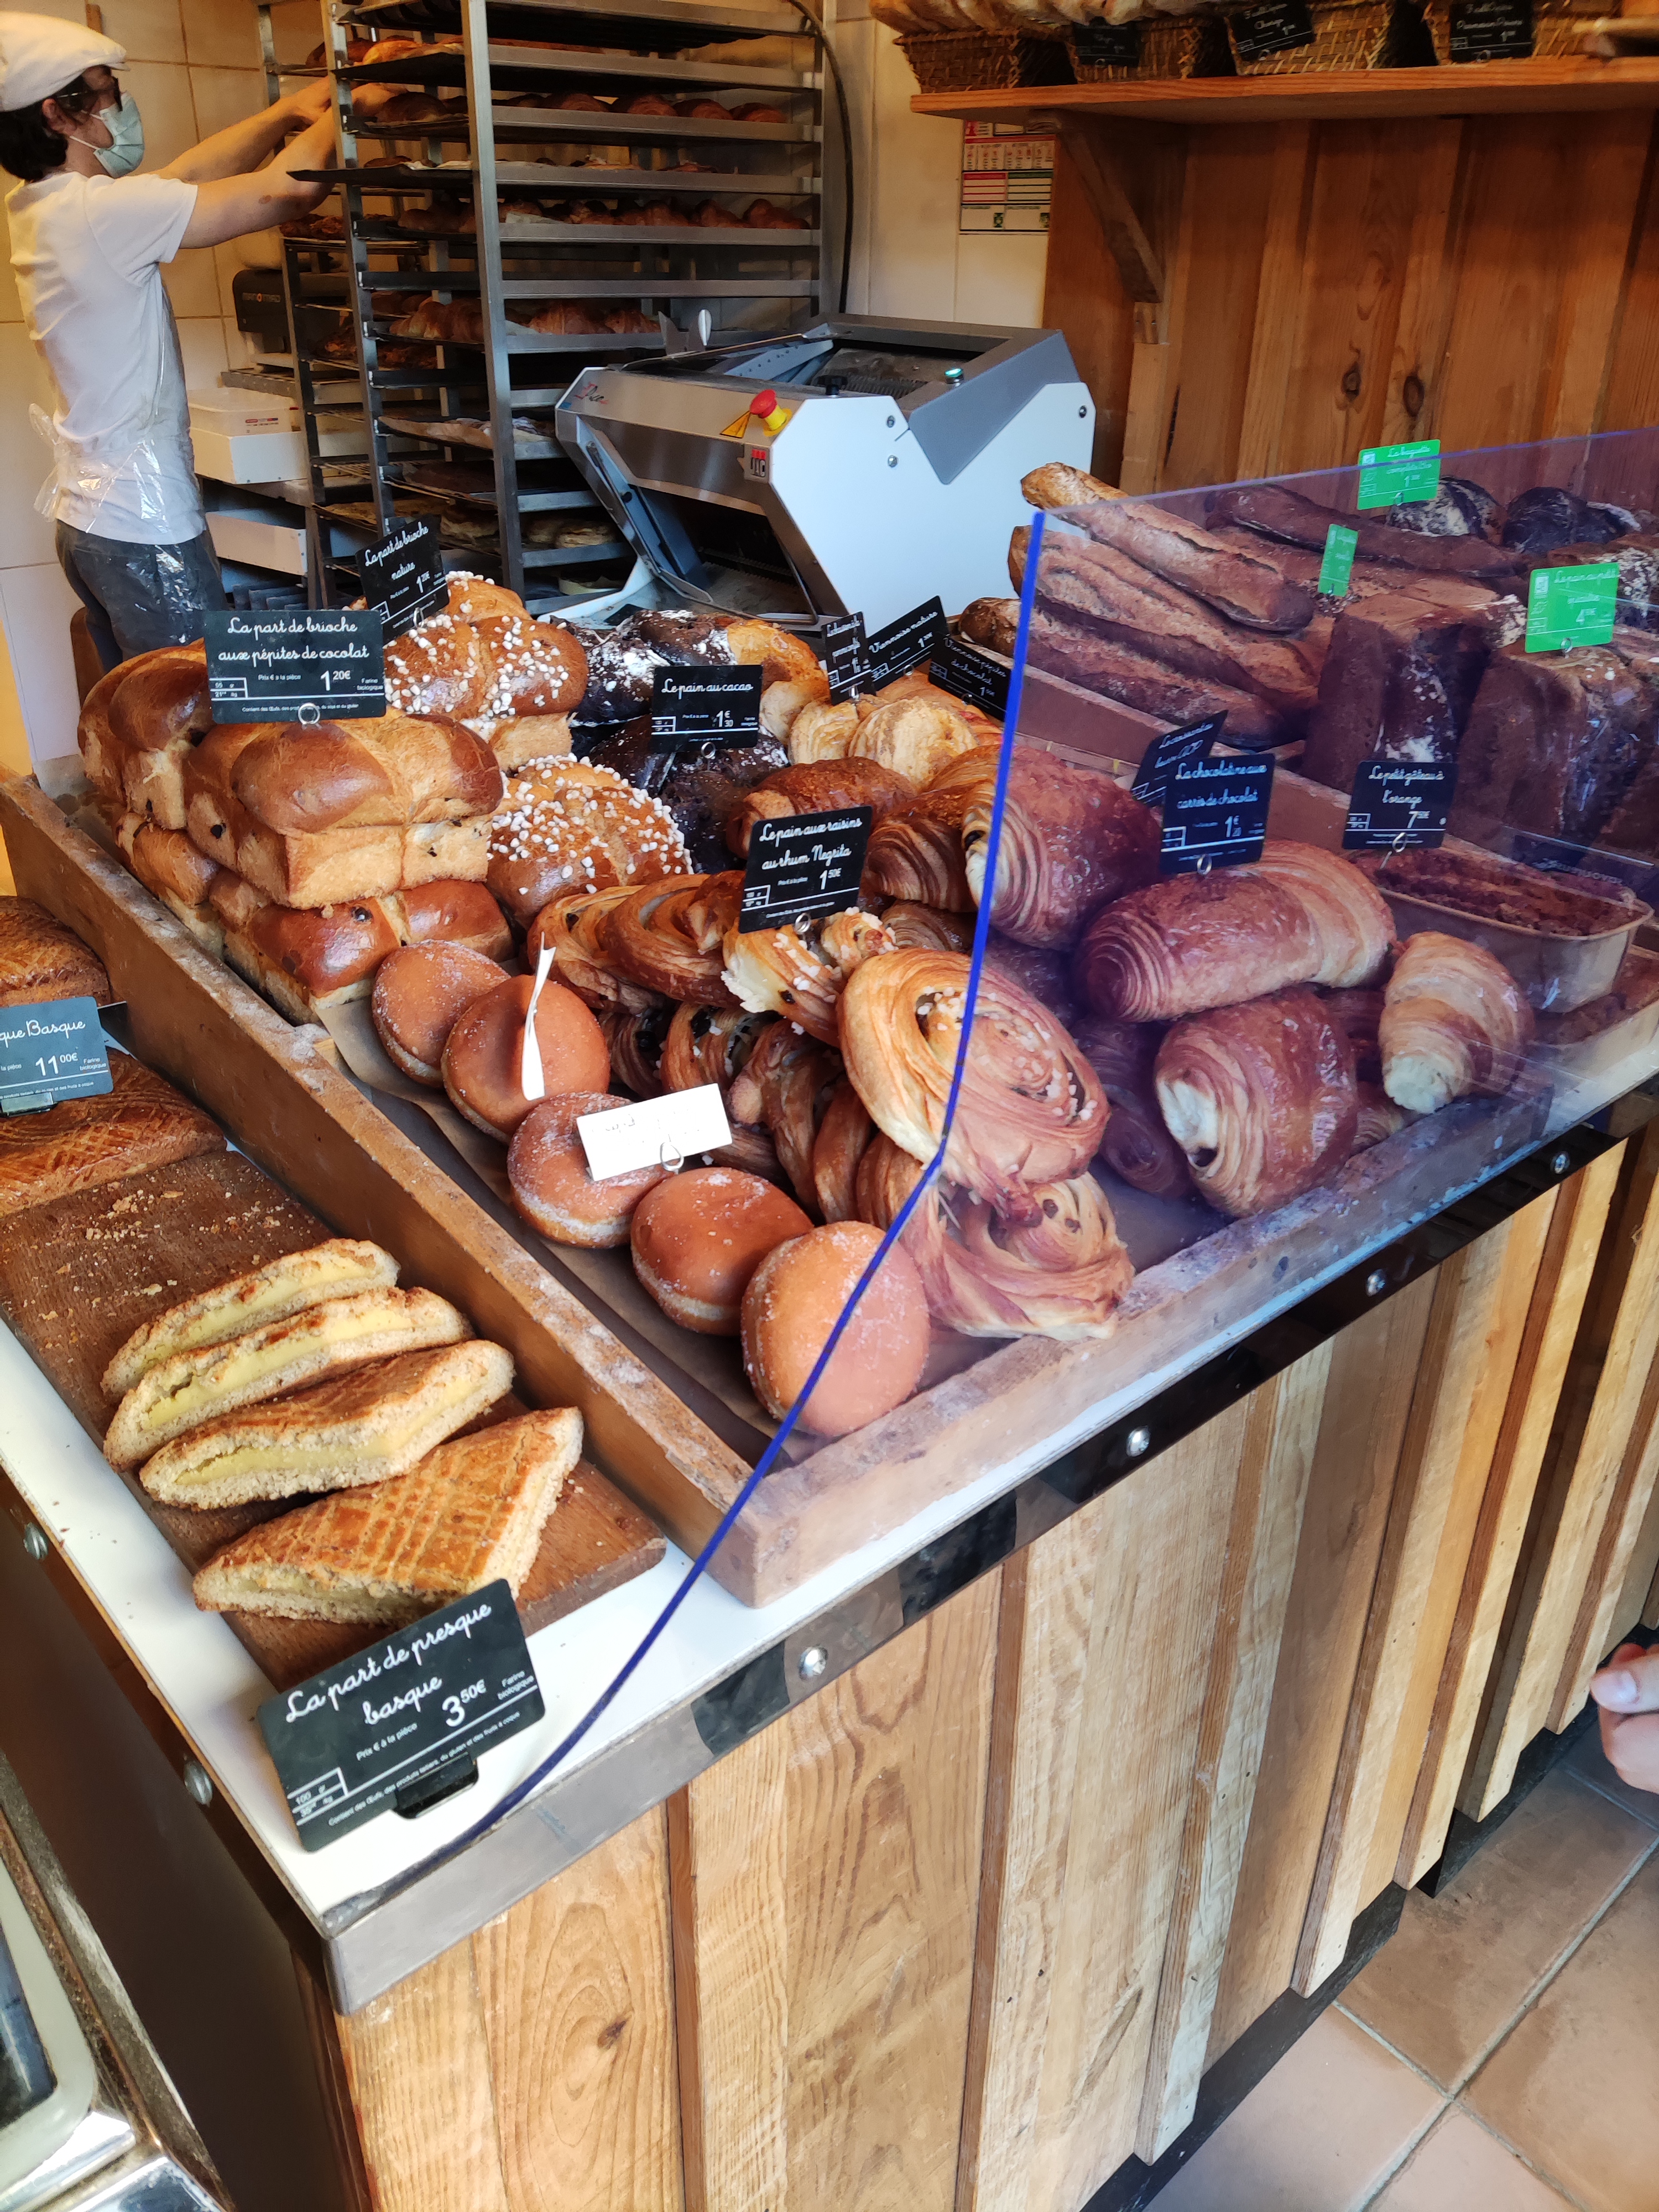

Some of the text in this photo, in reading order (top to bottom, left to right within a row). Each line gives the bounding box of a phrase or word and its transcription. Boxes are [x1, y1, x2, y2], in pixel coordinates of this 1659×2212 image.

[364, 521, 429, 567] La part de brioche
[391, 562, 416, 581] nature
[227, 616, 358, 641] La part de brioche
[218, 642, 370, 667] aux pépites de cocolat
[661, 678, 679, 693] Le
[676, 682, 706, 700] pain
[721, 684, 754, 692] cacao
[759, 817, 863, 847] Le pain aux raisins
[761, 843, 852, 870] au rhum Negrita
[26, 1019, 86, 1039] Basque
[80, 1062, 107, 1071] biologique
[285, 1604, 492, 1723] La part de presque
[497, 1675, 534, 1700] biologique
[501, 1670, 525, 1687] Farine
[362, 1676, 442, 1725] basque
[356, 1747, 373, 1761] Prix
[395, 1723, 418, 1740] pièce
